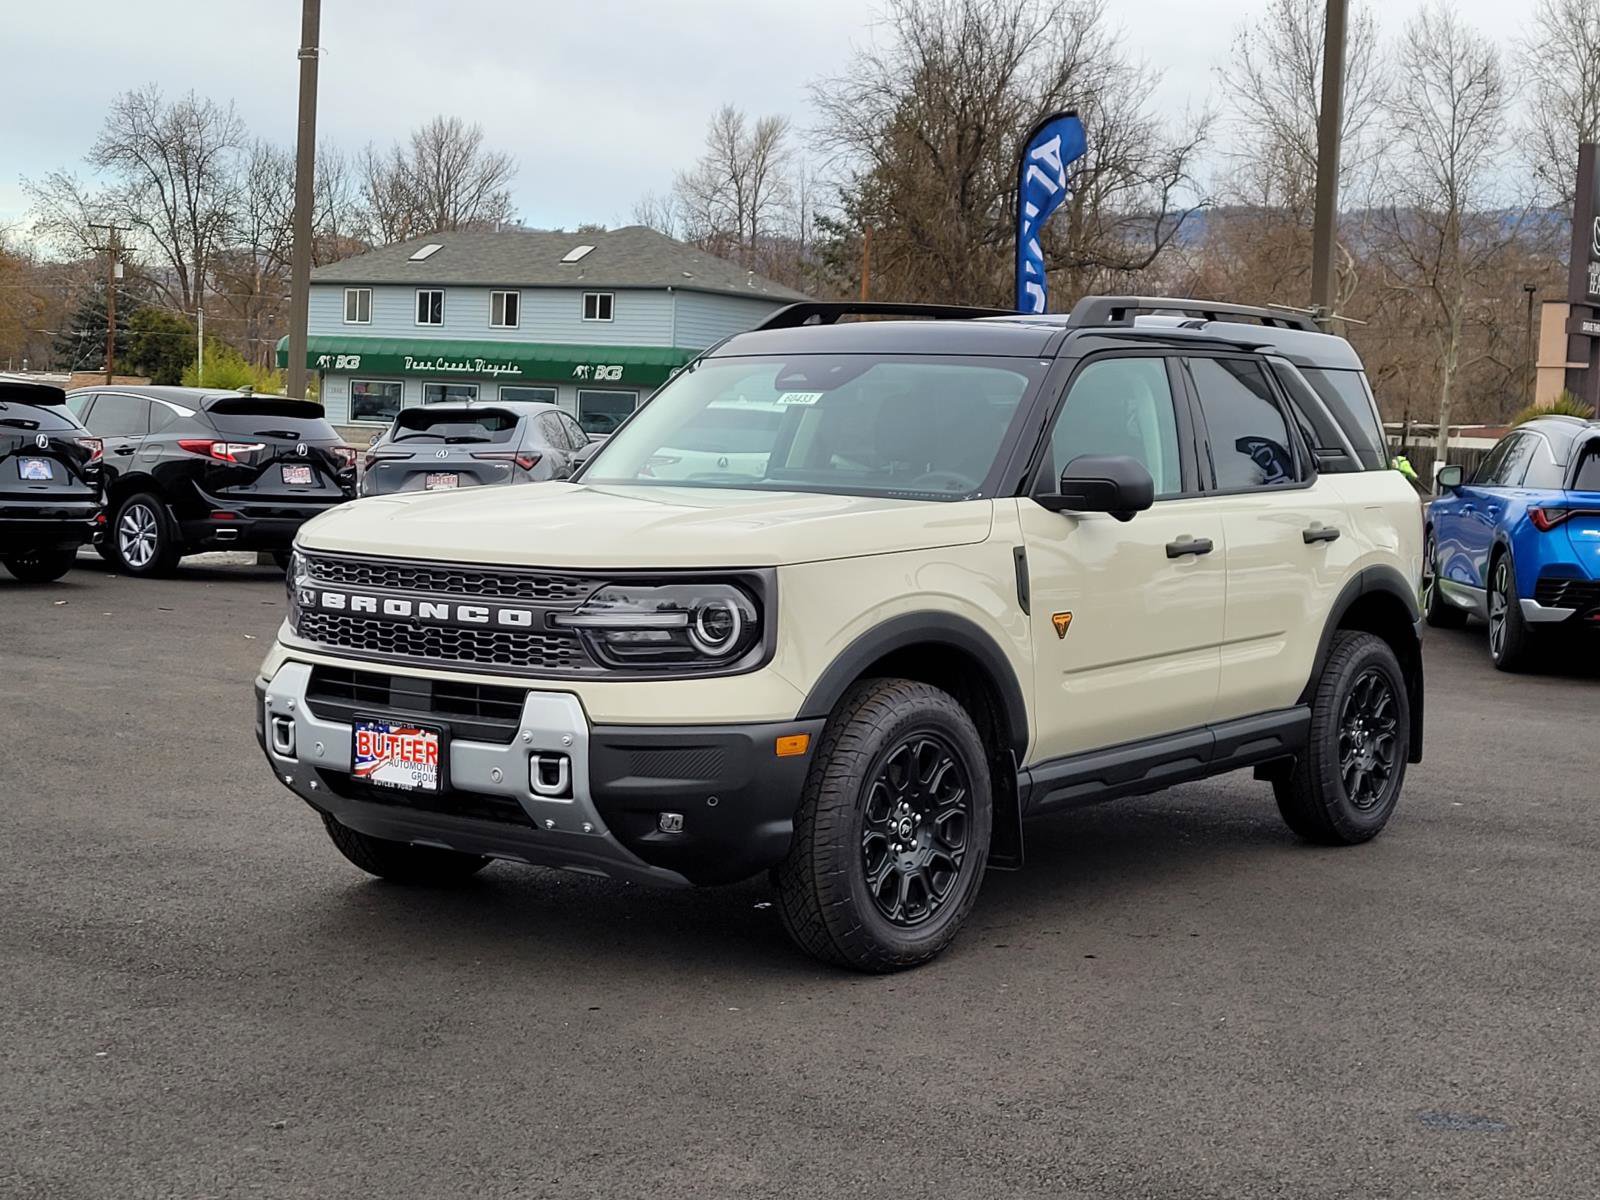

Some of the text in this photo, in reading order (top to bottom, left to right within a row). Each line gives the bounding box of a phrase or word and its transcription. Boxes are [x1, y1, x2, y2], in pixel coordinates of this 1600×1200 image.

[404, 356, 523, 377] Bear Creek Bicycle
[321, 591, 532, 627] BRONCO
[357, 731, 438, 766] BUTLER
[388, 758, 438, 773] AUTOMOTIVE
